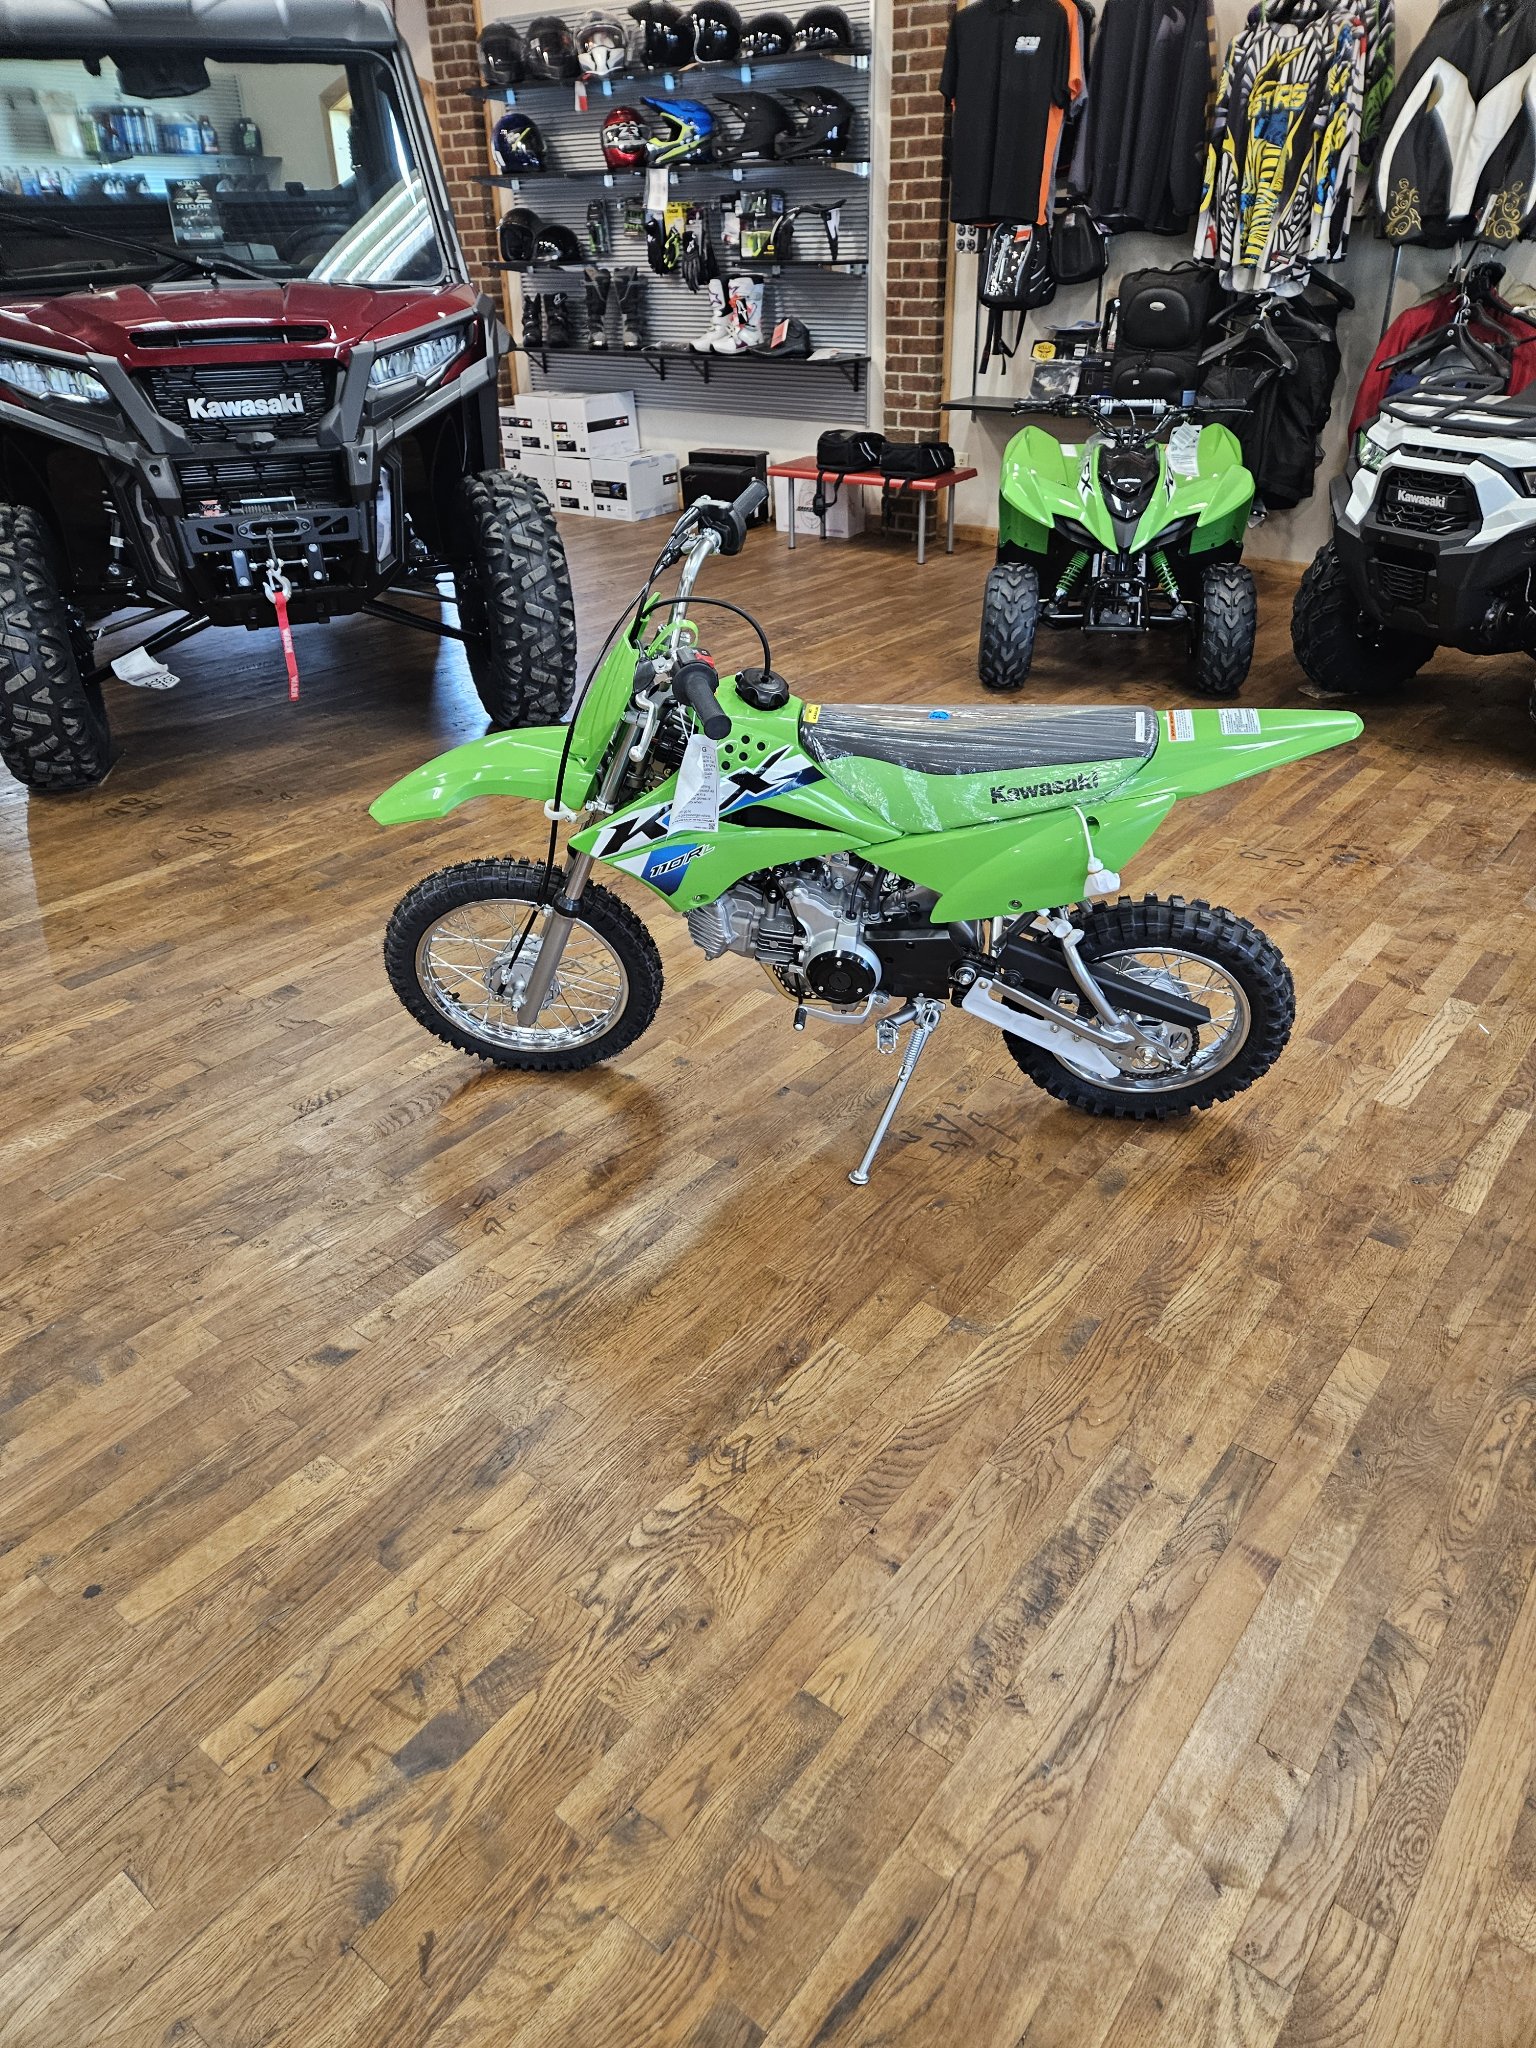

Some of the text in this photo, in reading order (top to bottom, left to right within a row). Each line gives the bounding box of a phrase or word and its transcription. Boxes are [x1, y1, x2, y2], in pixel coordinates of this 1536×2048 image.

[187, 393, 304, 419] Kawasaki
[1397, 489, 1446, 508] Kawasaki
[989, 770, 1099, 805] Kawasaki
